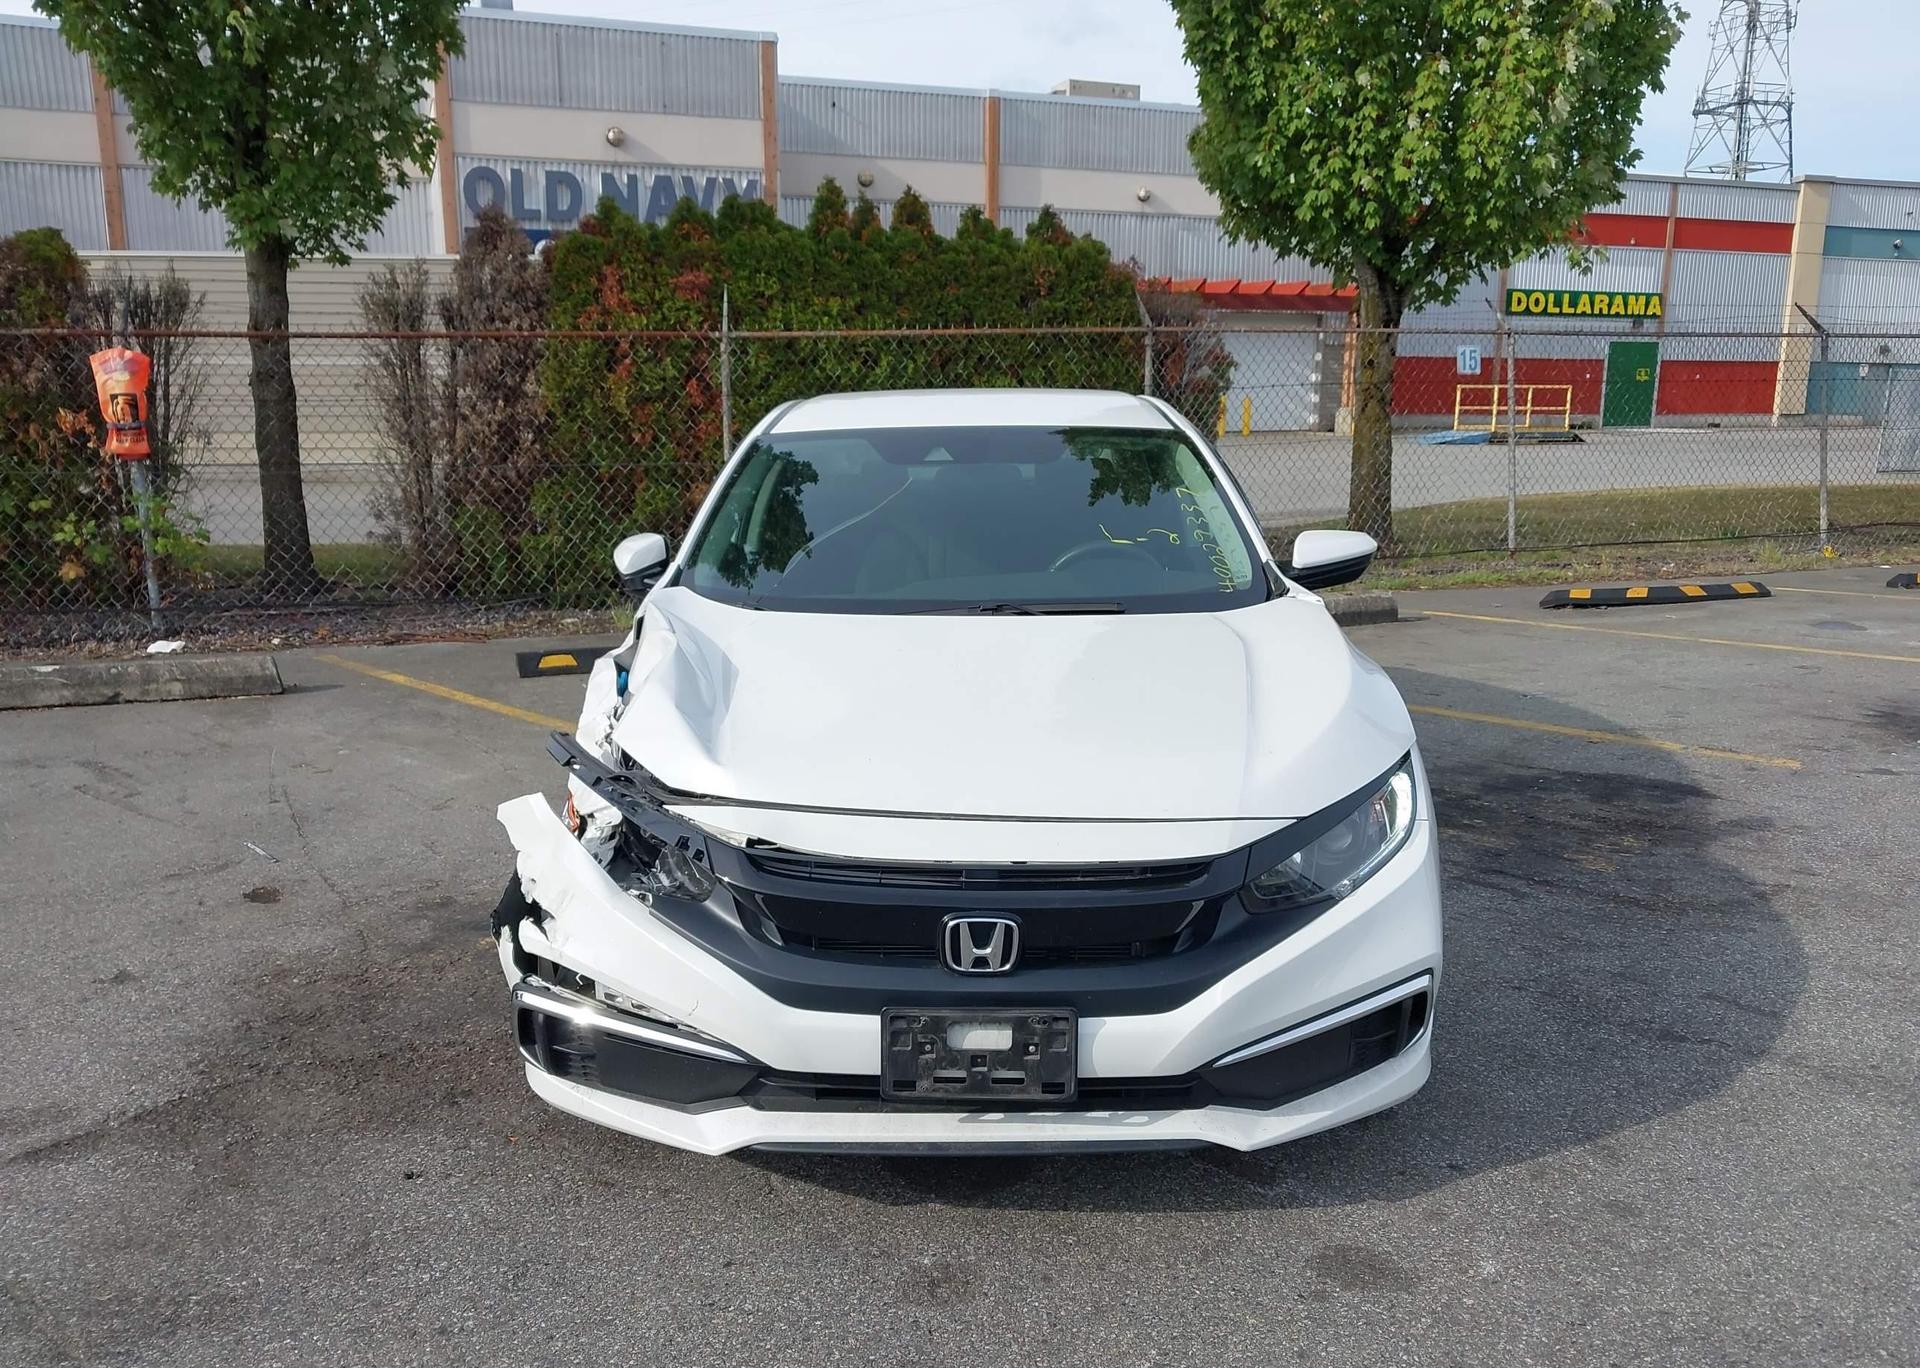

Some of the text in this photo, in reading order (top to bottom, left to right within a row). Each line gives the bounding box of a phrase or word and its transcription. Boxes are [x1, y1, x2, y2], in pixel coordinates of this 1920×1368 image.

[463, 166, 583, 221] OLD
[1510, 291, 1662, 316] DOLLARAMA
[1459, 349, 1478, 372] 15
